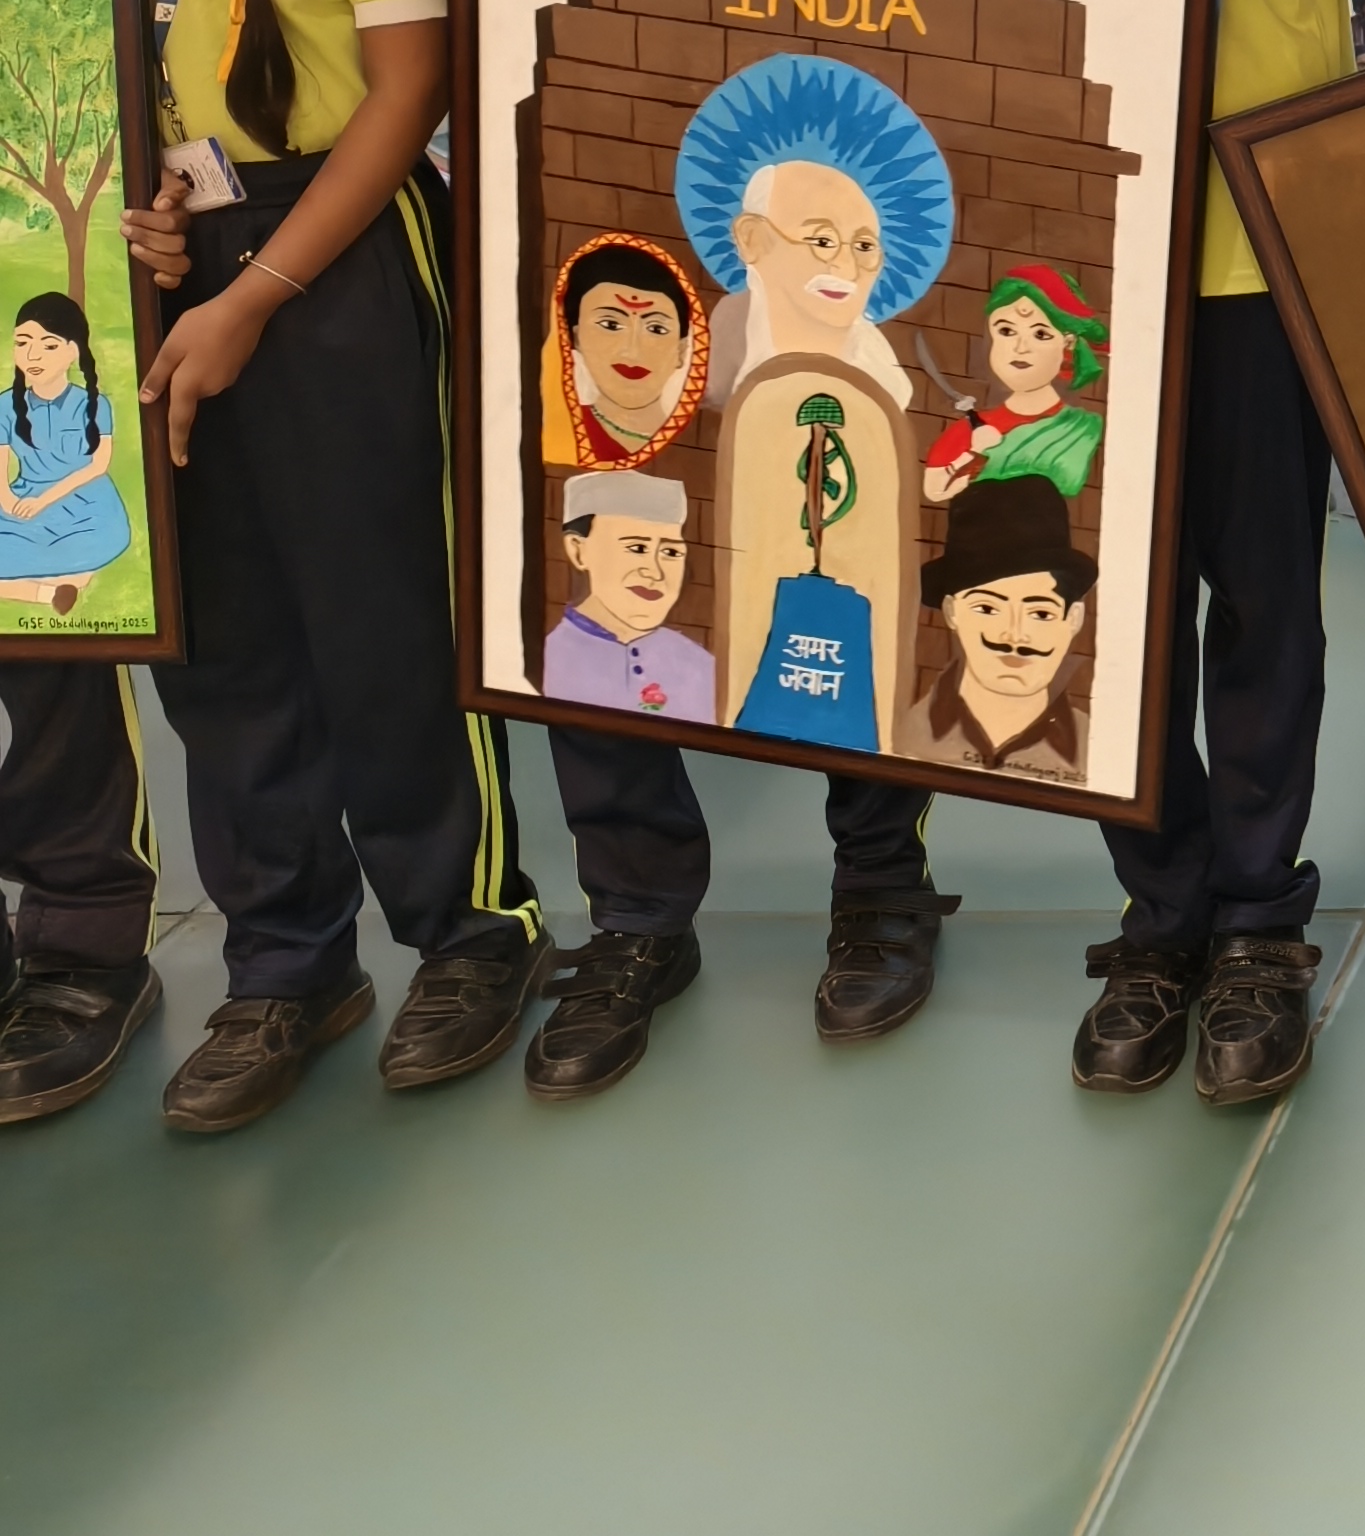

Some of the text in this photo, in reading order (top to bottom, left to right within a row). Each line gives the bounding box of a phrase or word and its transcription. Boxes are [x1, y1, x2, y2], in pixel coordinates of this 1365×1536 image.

[18, 617, 44, 630] GSE
[122, 617, 149, 629] 2025
[782, 634, 845, 664] अमर
[779, 662, 846, 701] जवान
